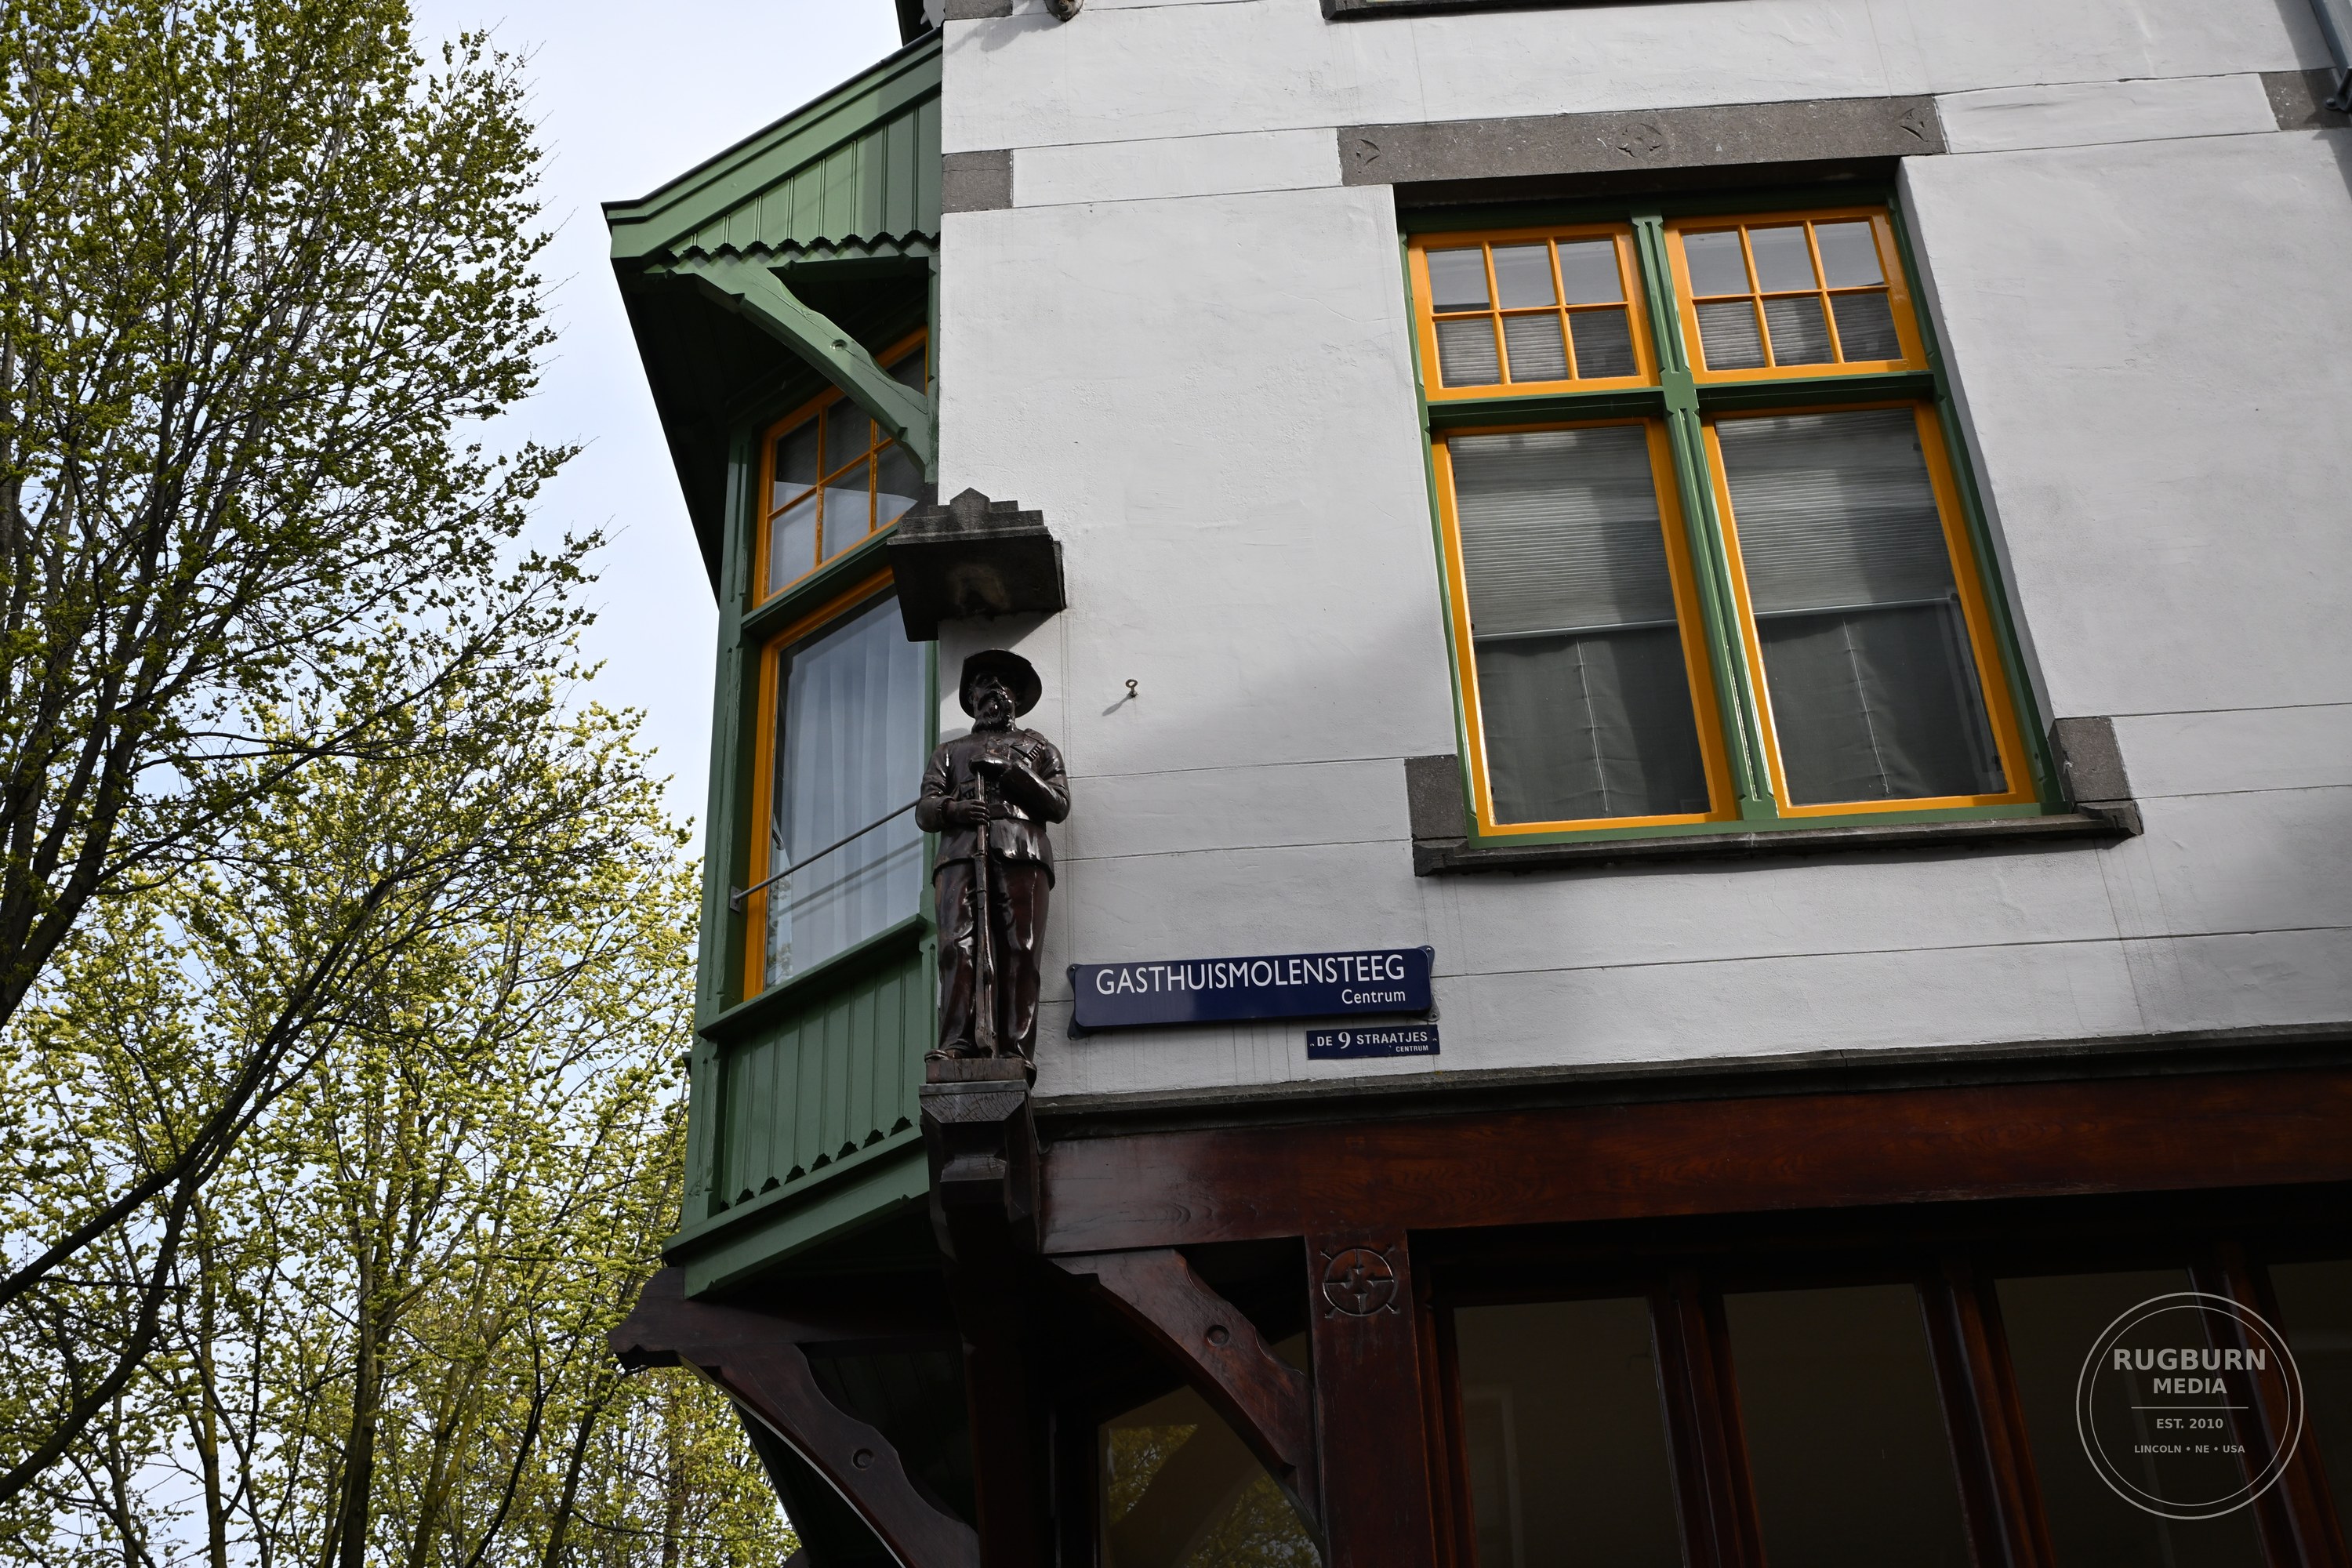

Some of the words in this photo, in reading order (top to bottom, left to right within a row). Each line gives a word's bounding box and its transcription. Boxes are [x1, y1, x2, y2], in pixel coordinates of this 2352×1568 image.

[1096, 954, 1405, 995] GASTHUISMOLENSTEEG
[1341, 989, 1406, 1005] Centrum
[1316, 1035, 1333, 1047] DE
[1338, 1031, 1351, 1049] 9
[1356, 1031, 1428, 1045] STRAATJES
